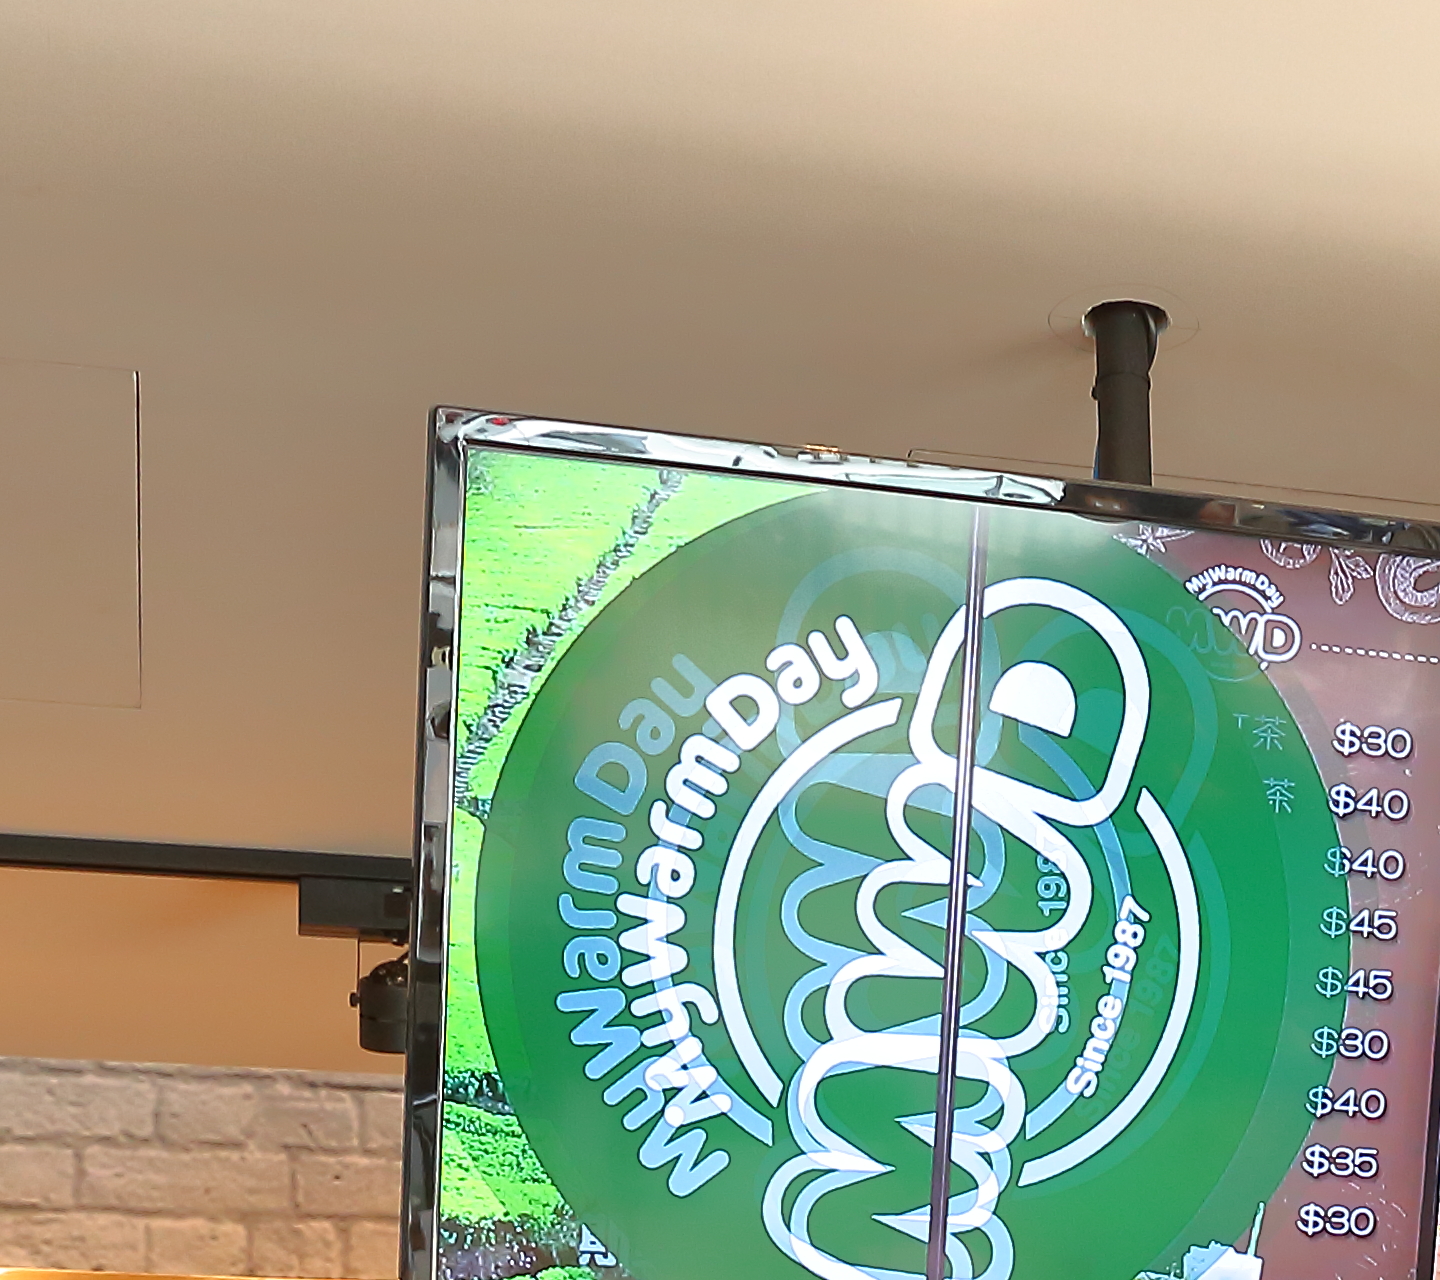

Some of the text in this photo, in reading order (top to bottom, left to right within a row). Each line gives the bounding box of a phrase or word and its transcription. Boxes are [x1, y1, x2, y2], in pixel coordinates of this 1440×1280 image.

[1332, 721, 1413, 760] $30
[1328, 782, 1409, 821] $40
[1323, 844, 1405, 881] $40
[1319, 906, 1399, 942] $45
[1064, 894, 1151, 1099] Since 1987
[1315, 966, 1394, 1001] $45
[1311, 1025, 1390, 1060] $30
[1305, 1085, 1387, 1120] $40
[1301, 1143, 1379, 1180] $35
[1296, 1202, 1376, 1239] $30
